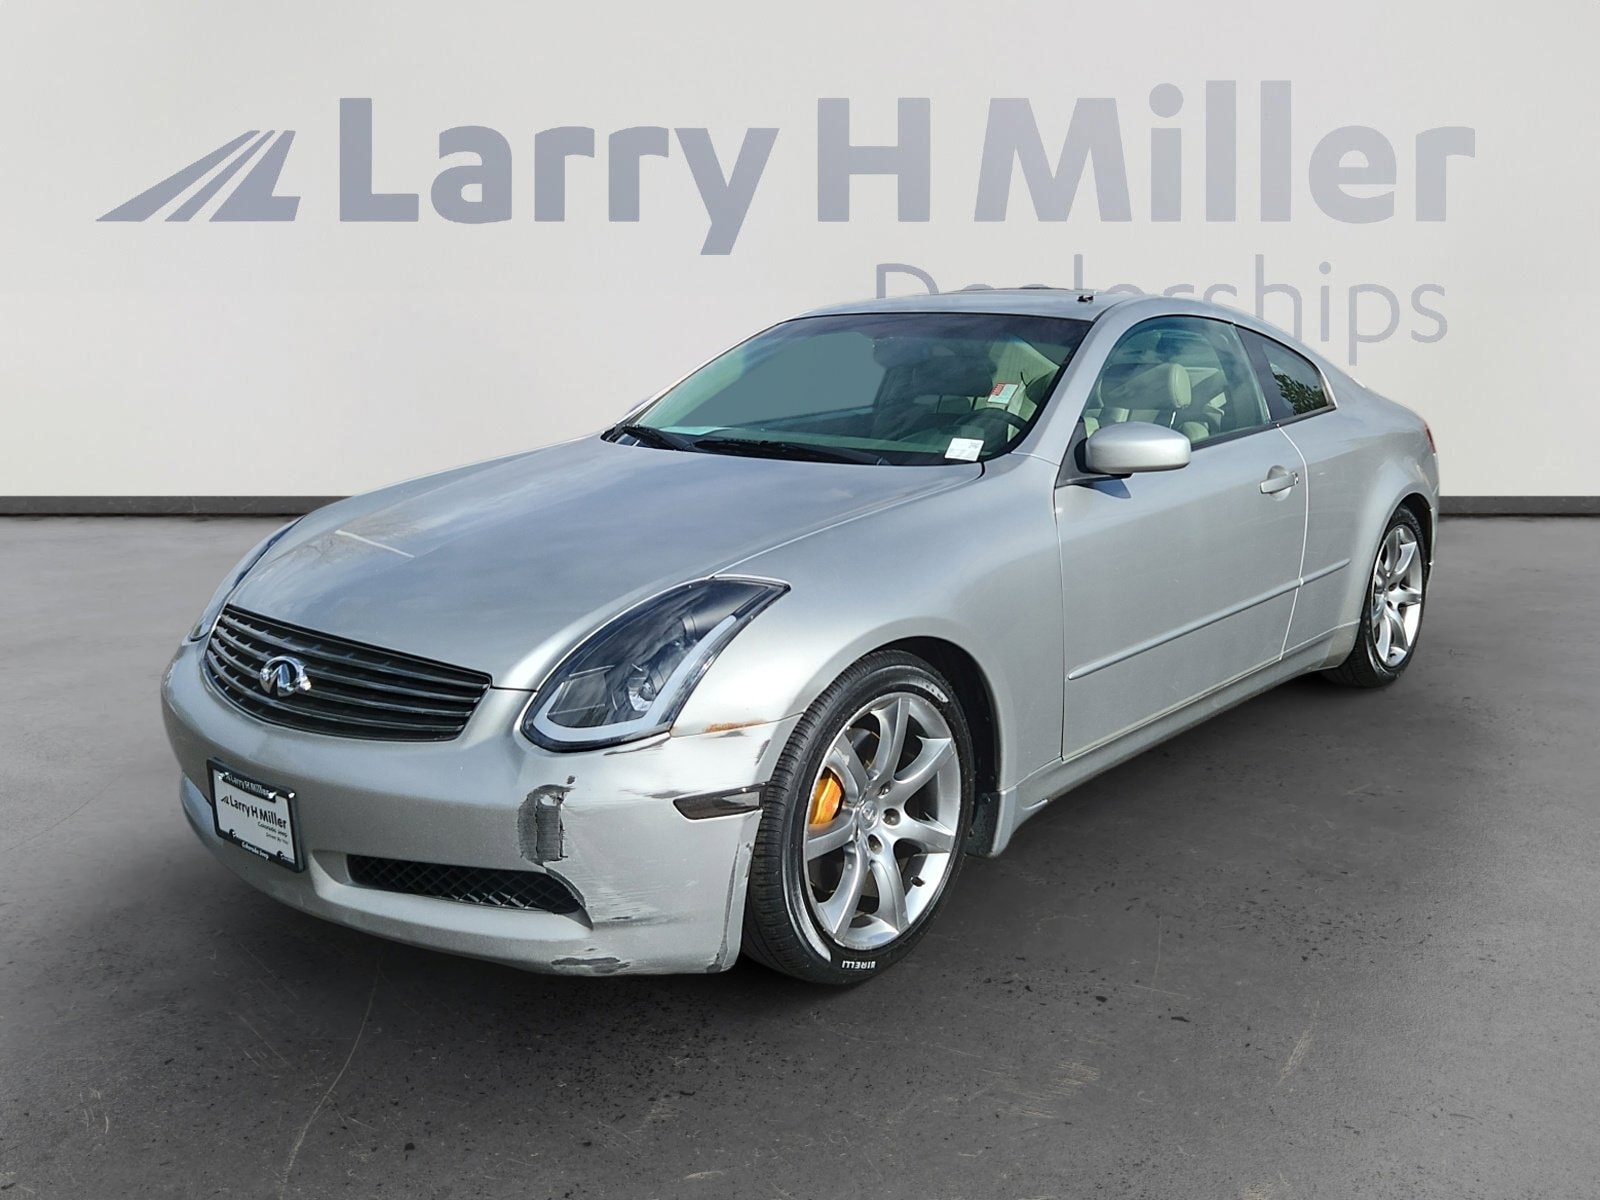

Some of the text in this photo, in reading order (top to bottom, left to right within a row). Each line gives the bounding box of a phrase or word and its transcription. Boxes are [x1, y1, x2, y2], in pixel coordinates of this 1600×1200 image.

[339, 80, 1476, 255] Larry H Miller
[229, 795, 287, 829] Larry H Miller
